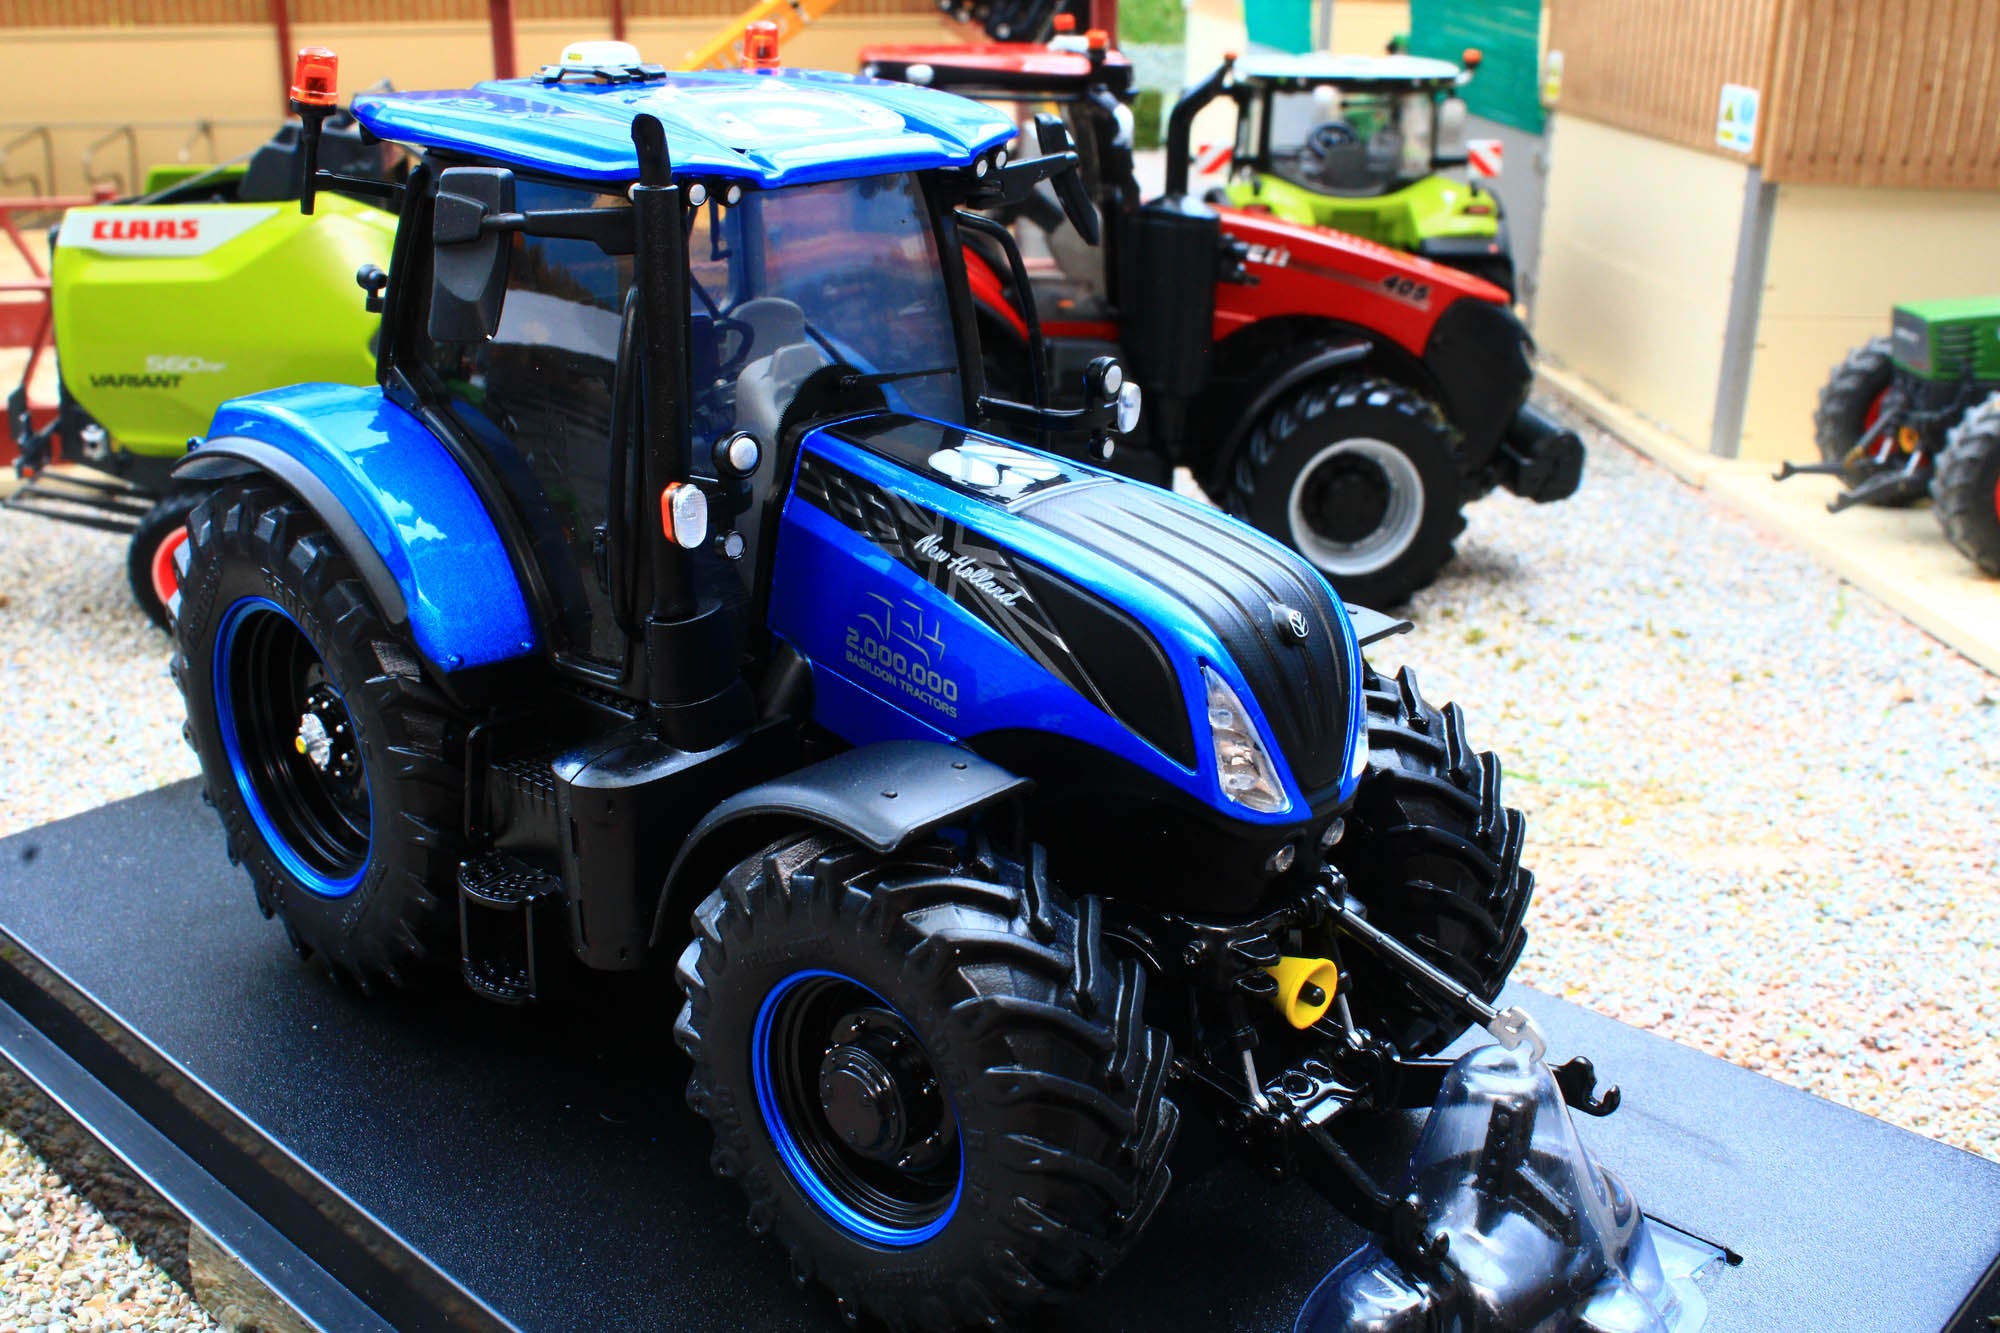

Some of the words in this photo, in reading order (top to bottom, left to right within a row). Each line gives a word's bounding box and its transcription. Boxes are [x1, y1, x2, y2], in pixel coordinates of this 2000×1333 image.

[93, 219, 199, 240] CLAAS
[1384, 275, 1429, 301] 405
[90, 373, 182, 389] VARIANT
[913, 534, 950, 563] New
[947, 556, 1023, 606] Holland
[846, 626, 958, 702] 2.000.000
[846, 650, 897, 686] BASILDON
[900, 679, 957, 719] TRACTORS
